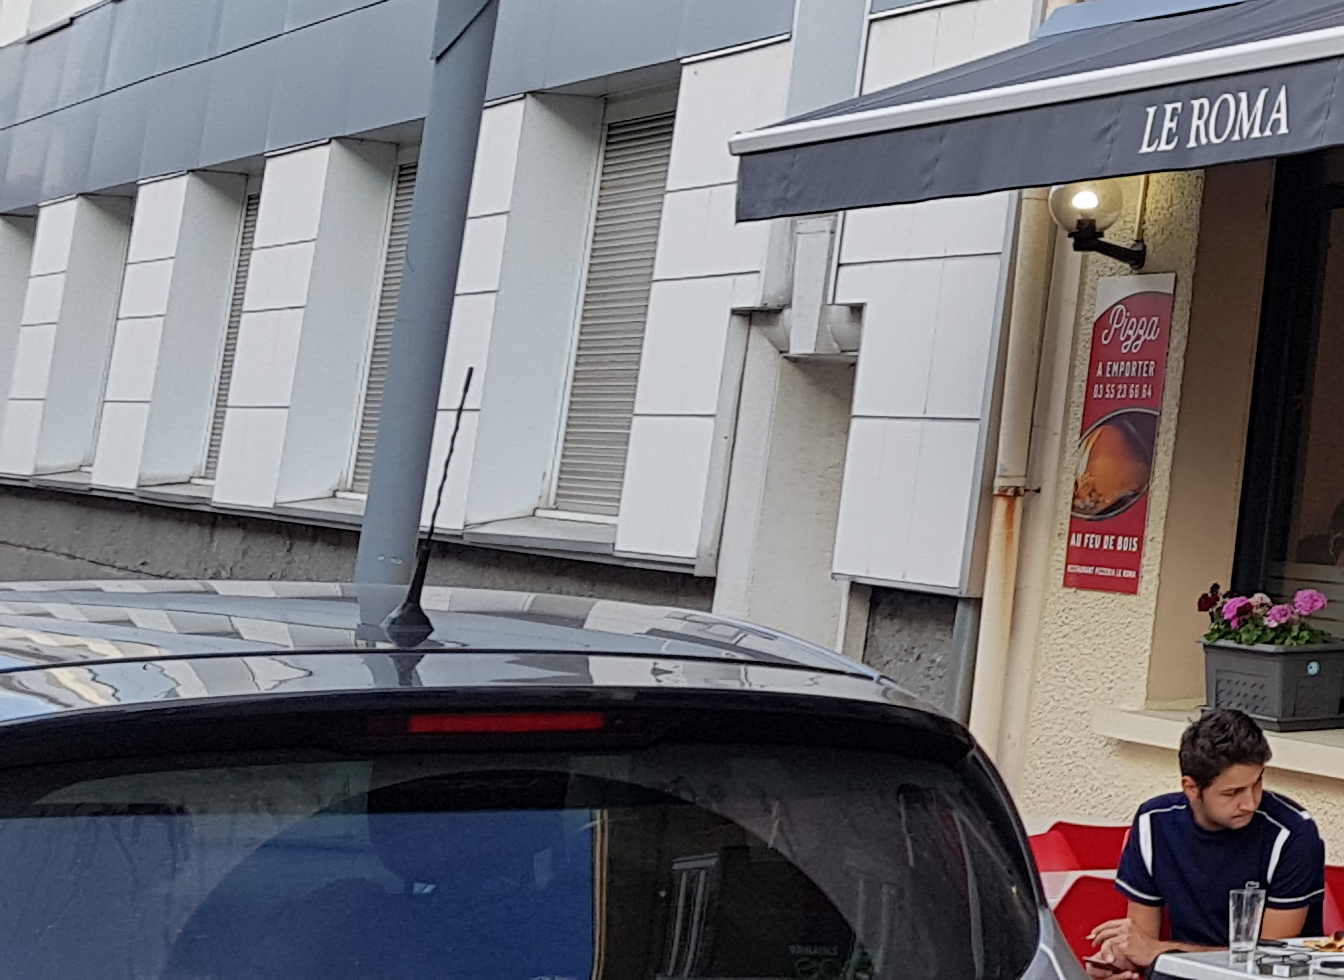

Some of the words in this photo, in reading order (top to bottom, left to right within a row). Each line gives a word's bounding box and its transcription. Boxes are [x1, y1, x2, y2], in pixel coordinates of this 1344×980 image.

[1138, 102, 1183, 154] LE
[1186, 84, 1290, 149] ROMA
[1101, 304, 1160, 354] Pizza
[1096, 361, 1103, 377] A
[1105, 360, 1156, 378] EMPORTER
[1093, 383, 1104, 399] 03
[1070, 532, 1082, 548] AU
[1083, 533, 1102, 549] FEU
[1103, 534, 1116, 550] DE
[1117, 535, 1139, 552] BOIS
